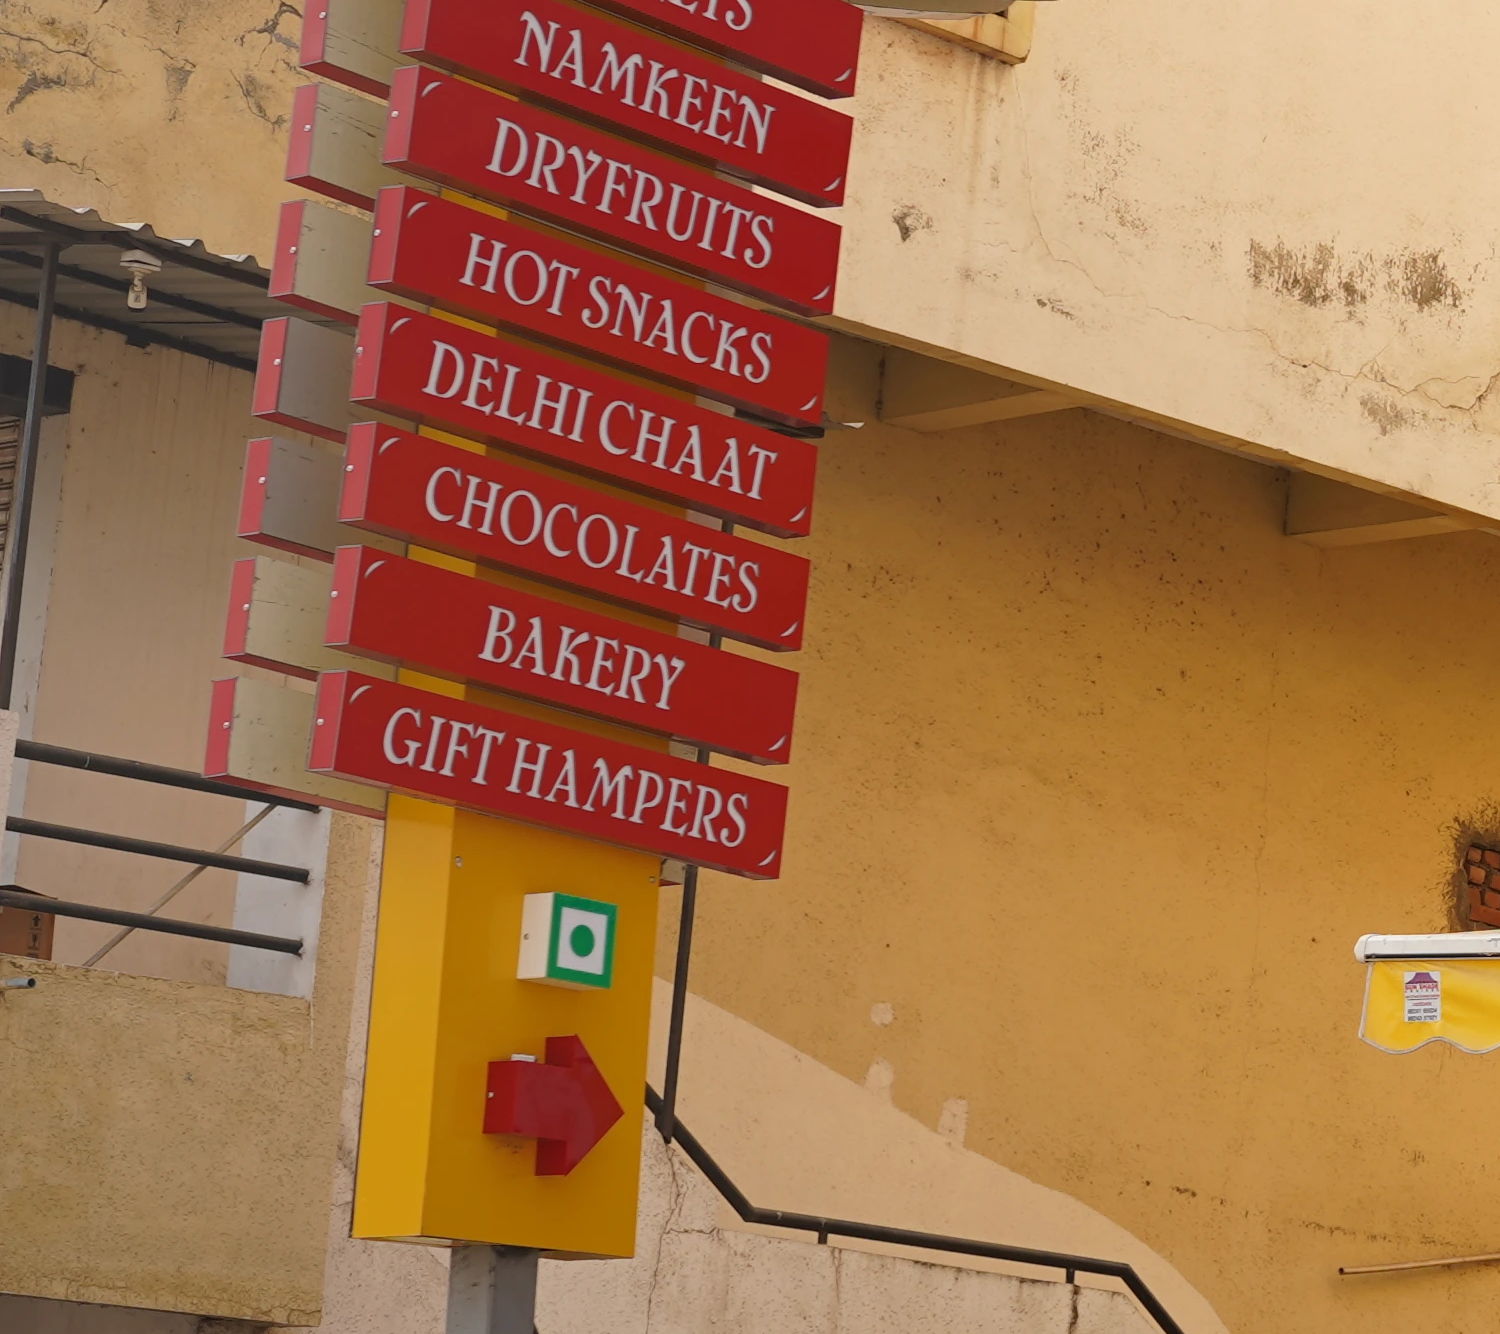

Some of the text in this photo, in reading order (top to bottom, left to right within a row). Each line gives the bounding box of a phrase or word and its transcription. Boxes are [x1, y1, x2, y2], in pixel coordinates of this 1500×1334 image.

[514, 12, 775, 154] NAMKEEN
[486, 120, 773, 269] DRYFRUITS
[459, 232, 772, 383] HOT SNACKS
[423, 341, 777, 500] DELHI CHAAT
[425, 467, 759, 614] CHOCOLATES
[479, 606, 685, 712] BAKERY
[382, 707, 748, 848] GIFT HAMPERS
